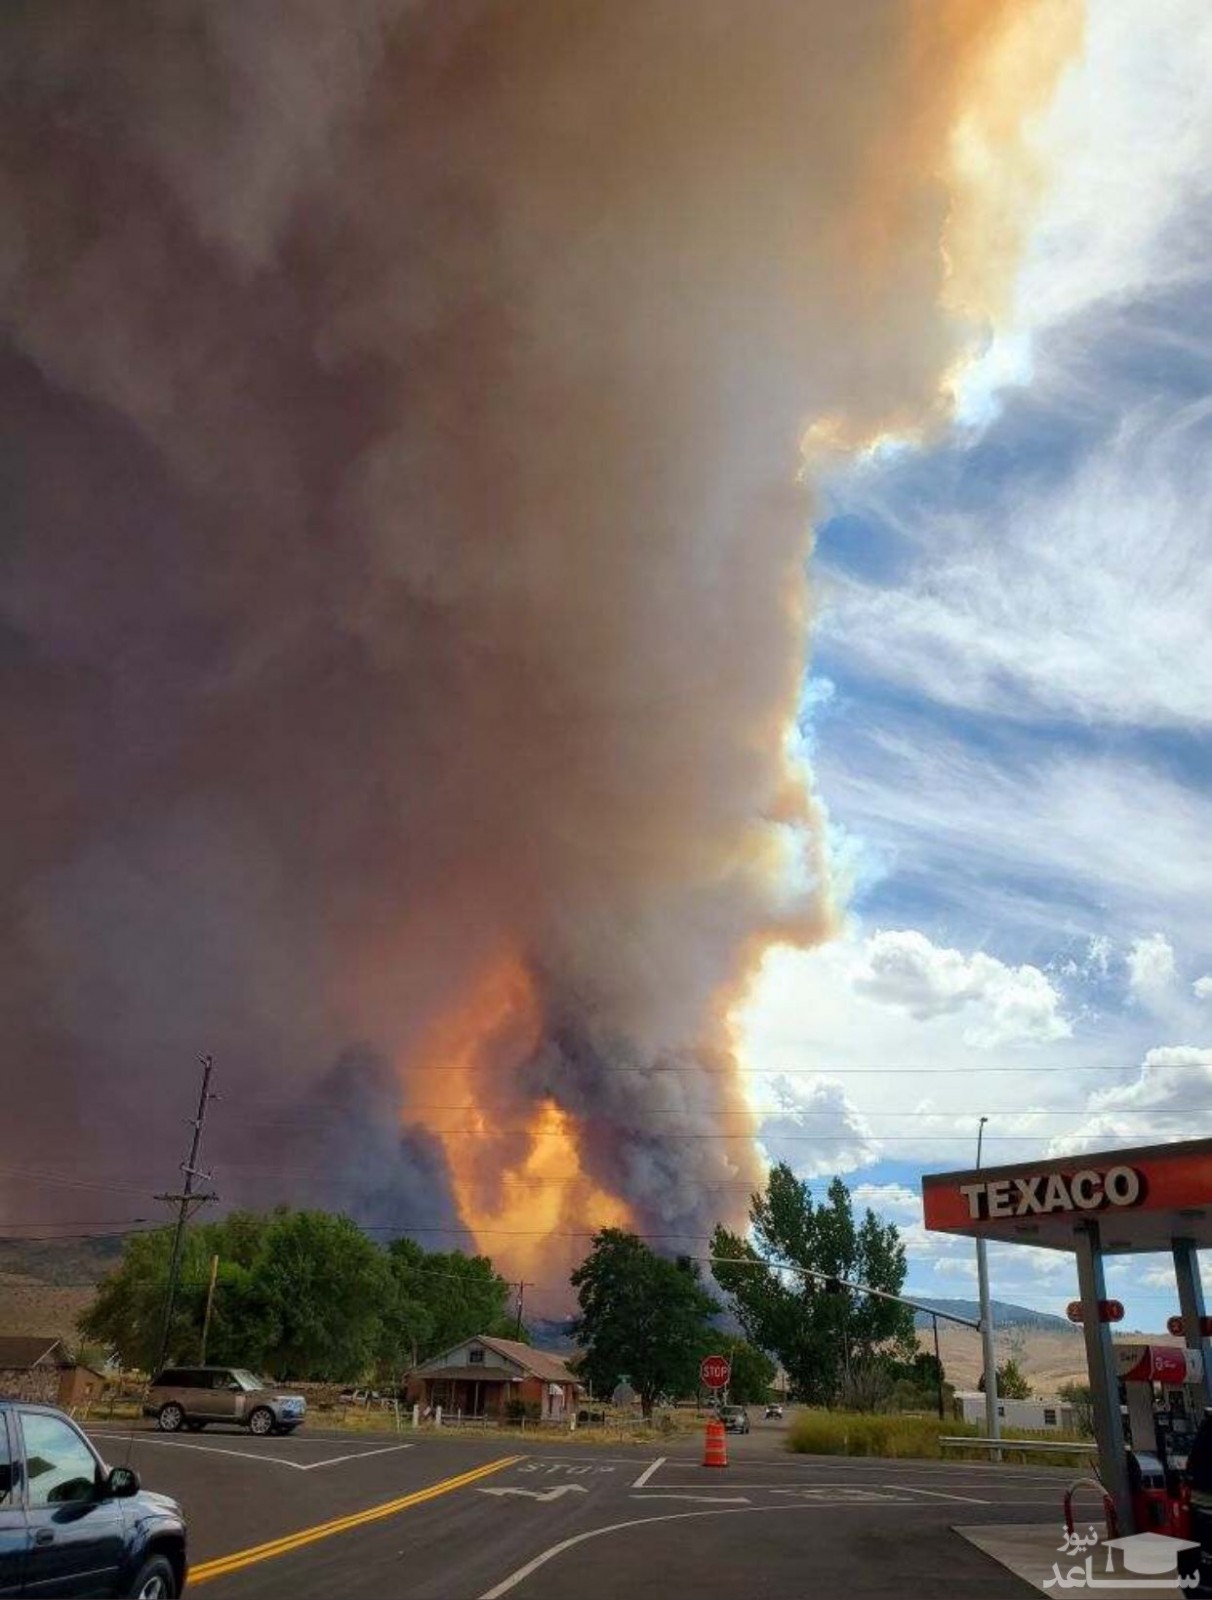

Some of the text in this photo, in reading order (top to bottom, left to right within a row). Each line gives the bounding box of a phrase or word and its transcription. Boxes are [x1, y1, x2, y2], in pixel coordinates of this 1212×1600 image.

[960, 1165, 1139, 1219] TEXACO
[703, 1366, 728, 1378] STOP
[517, 1463, 616, 1474] STOP
